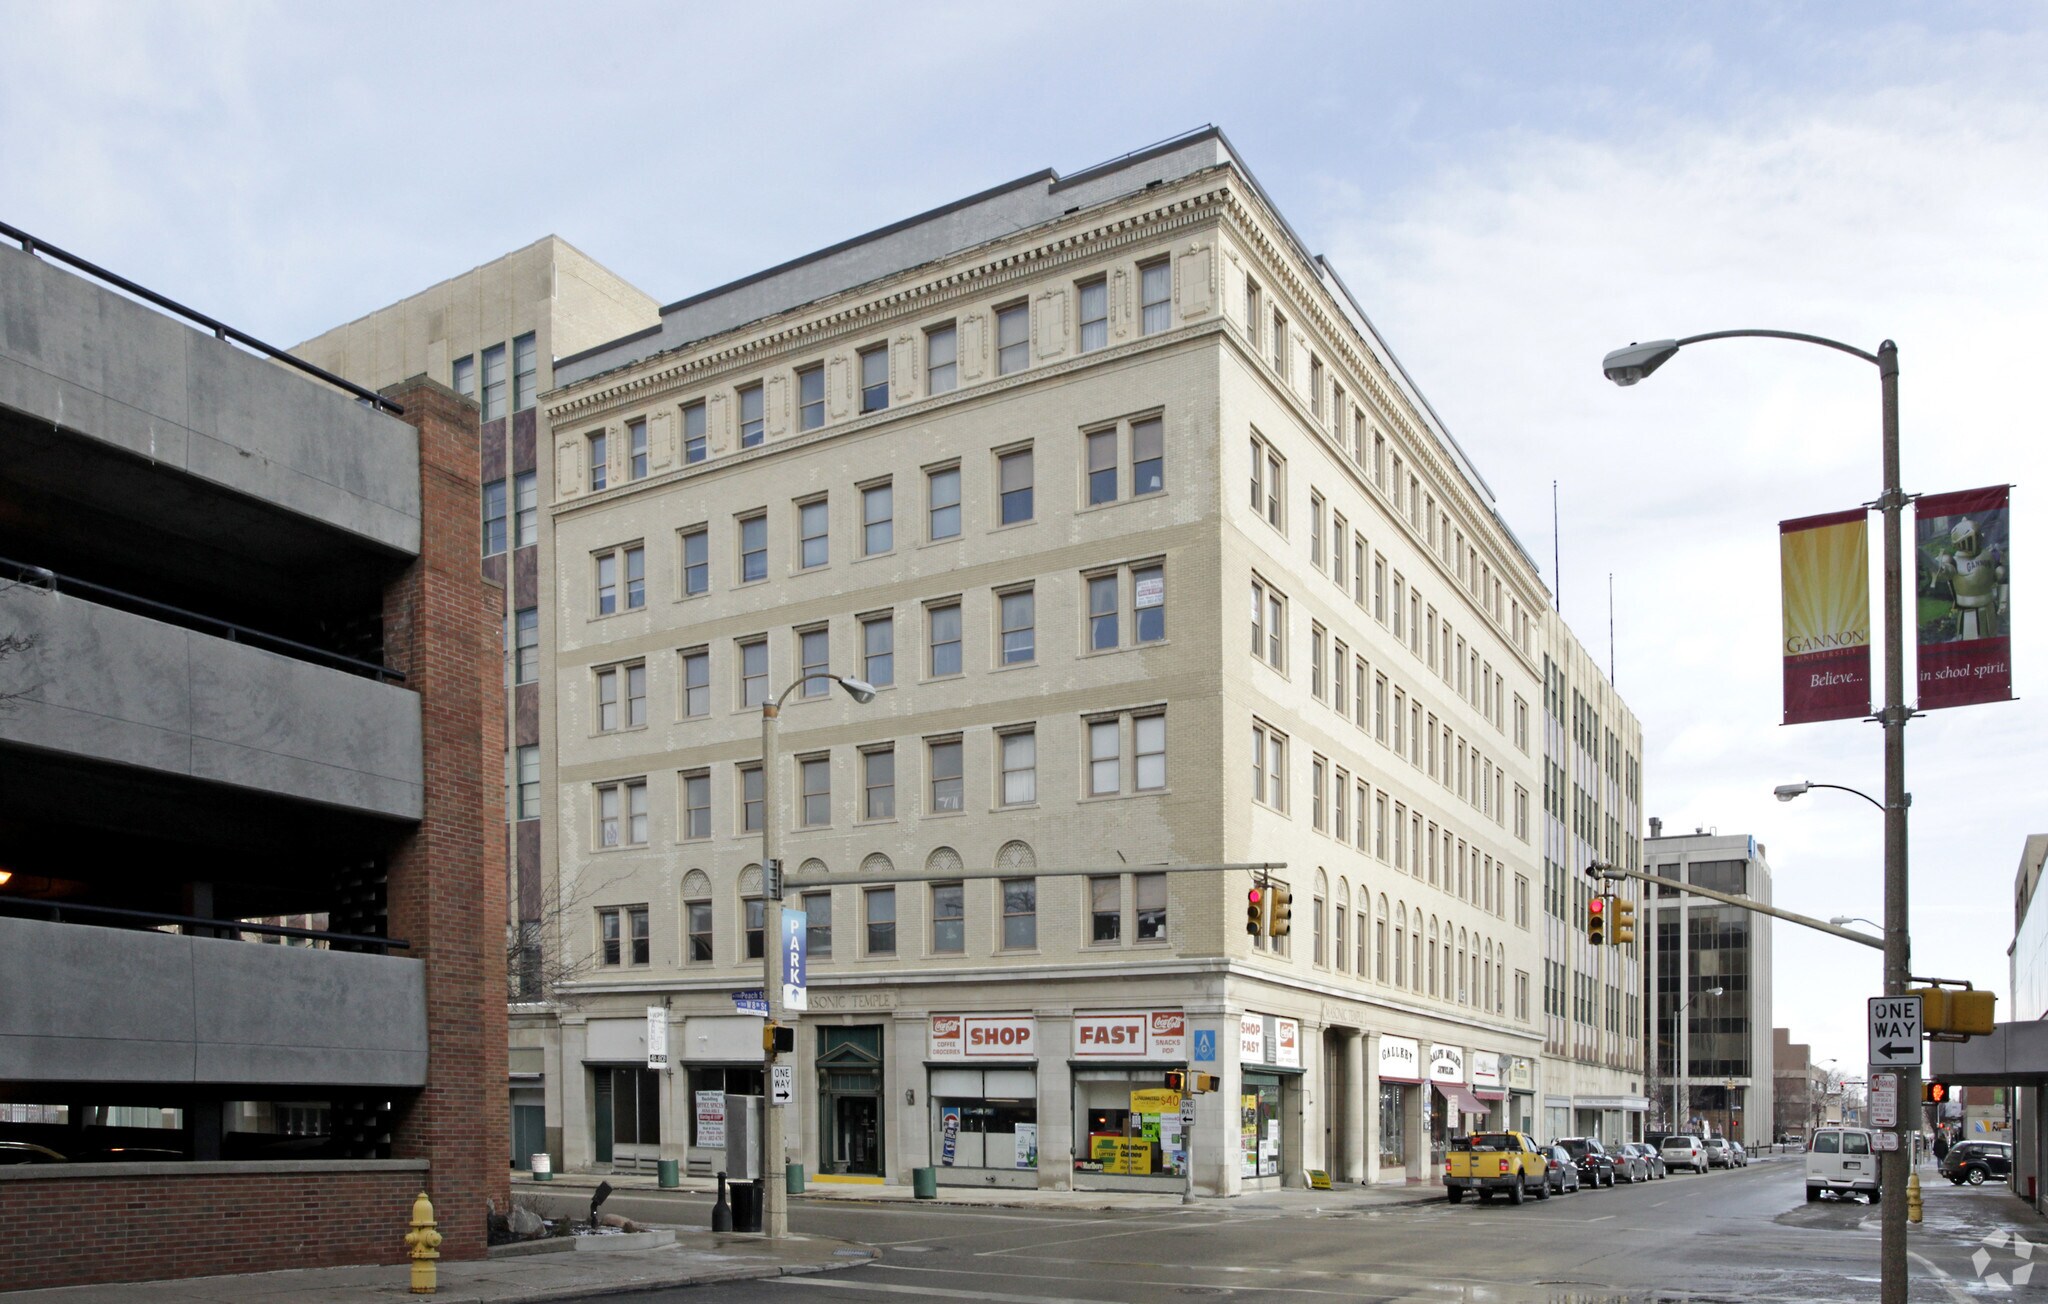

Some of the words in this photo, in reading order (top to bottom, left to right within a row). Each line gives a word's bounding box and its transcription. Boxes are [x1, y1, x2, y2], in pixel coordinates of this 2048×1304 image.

[1787, 630, 1864, 653] GANNON
[1797, 648, 1856, 661] UNIVERSITY
[1920, 670, 1931, 681] in
[1935, 663, 1970, 680] school
[1974, 662, 2008, 678] spirit.
[1810, 671, 1863, 687] Believe...
[790, 919, 800, 984] PARK
[741, 991, 758, 999] Peach
[853, 994, 889, 1007] TEMPLE
[760, 1002, 767, 1010] St
[1875, 1003, 1914, 1019] ONE
[1080, 1026, 1139, 1044] FAST
[1241, 1022, 1260, 1035] SHOP
[1874, 1022, 1915, 1037] WAY
[970, 1027, 1030, 1045] SHOP
[1242, 1040, 1259, 1053] FAST
[1382, 1046, 1412, 1063] GALLERY
[774, 1068, 789, 1077] ONE
[774, 1079, 790, 1088] WAY
[1161, 1095, 1179, 1107] $40
